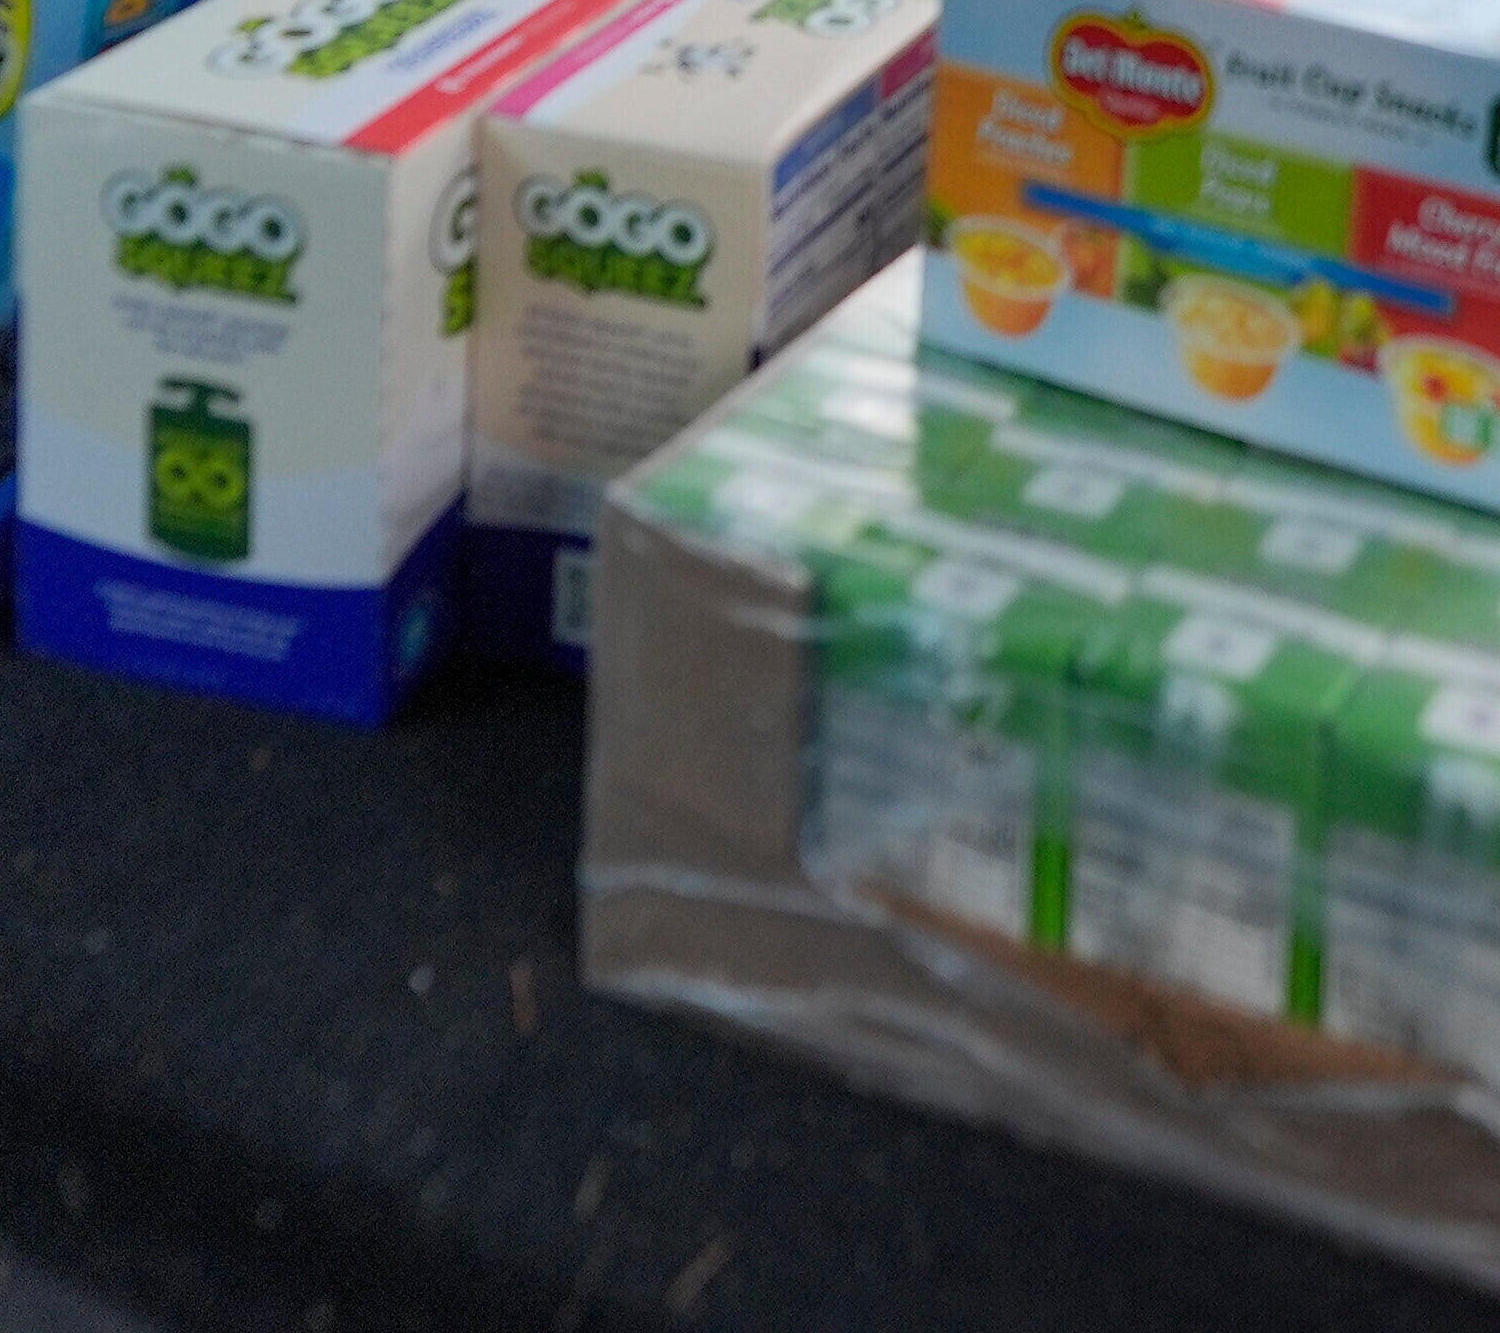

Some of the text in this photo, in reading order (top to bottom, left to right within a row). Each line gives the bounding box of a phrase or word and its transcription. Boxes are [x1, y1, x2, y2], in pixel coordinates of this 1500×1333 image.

[1112, 47, 1203, 106] Monte
[105, 179, 303, 263] GOGO
[515, 179, 712, 266] GOGO
